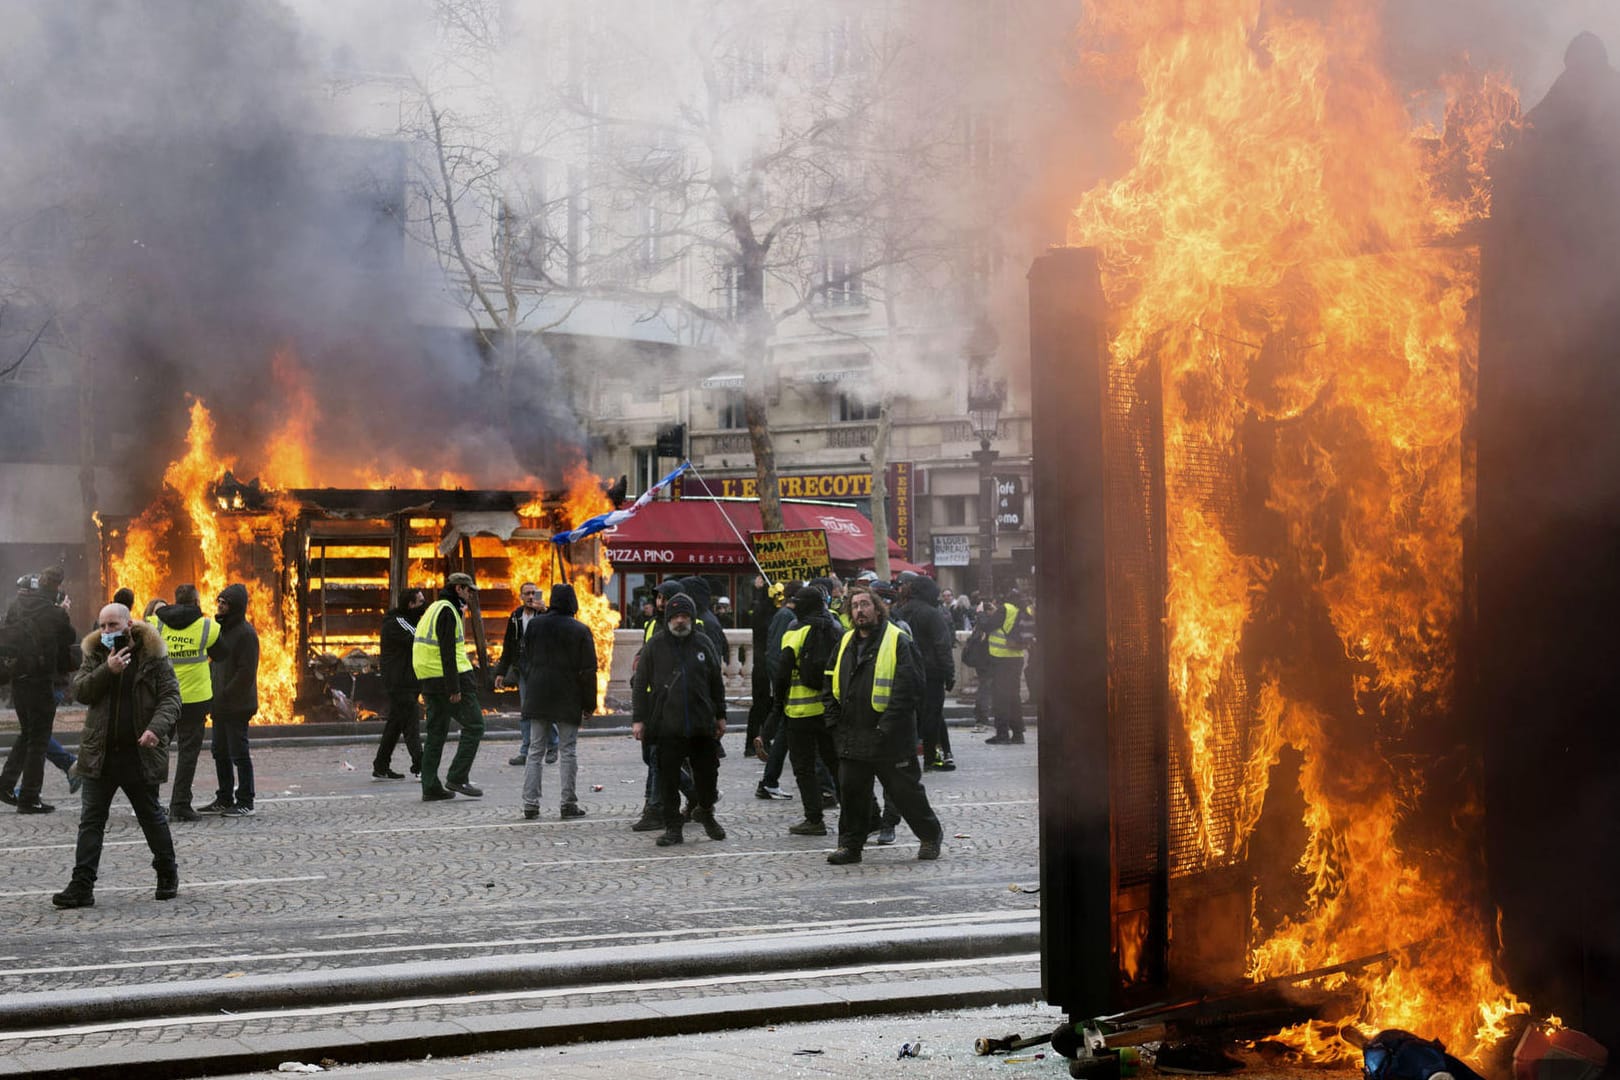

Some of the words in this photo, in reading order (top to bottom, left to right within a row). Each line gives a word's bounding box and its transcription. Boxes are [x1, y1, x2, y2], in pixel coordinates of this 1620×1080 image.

[756, 541, 785, 553] PAPA
[605, 550, 641, 562] PIZZA
[644, 550, 674, 562] PINO
[167, 635, 194, 644] FORCE
[173, 643, 185, 651] ET
[167, 649, 198, 658] ONNEUR
